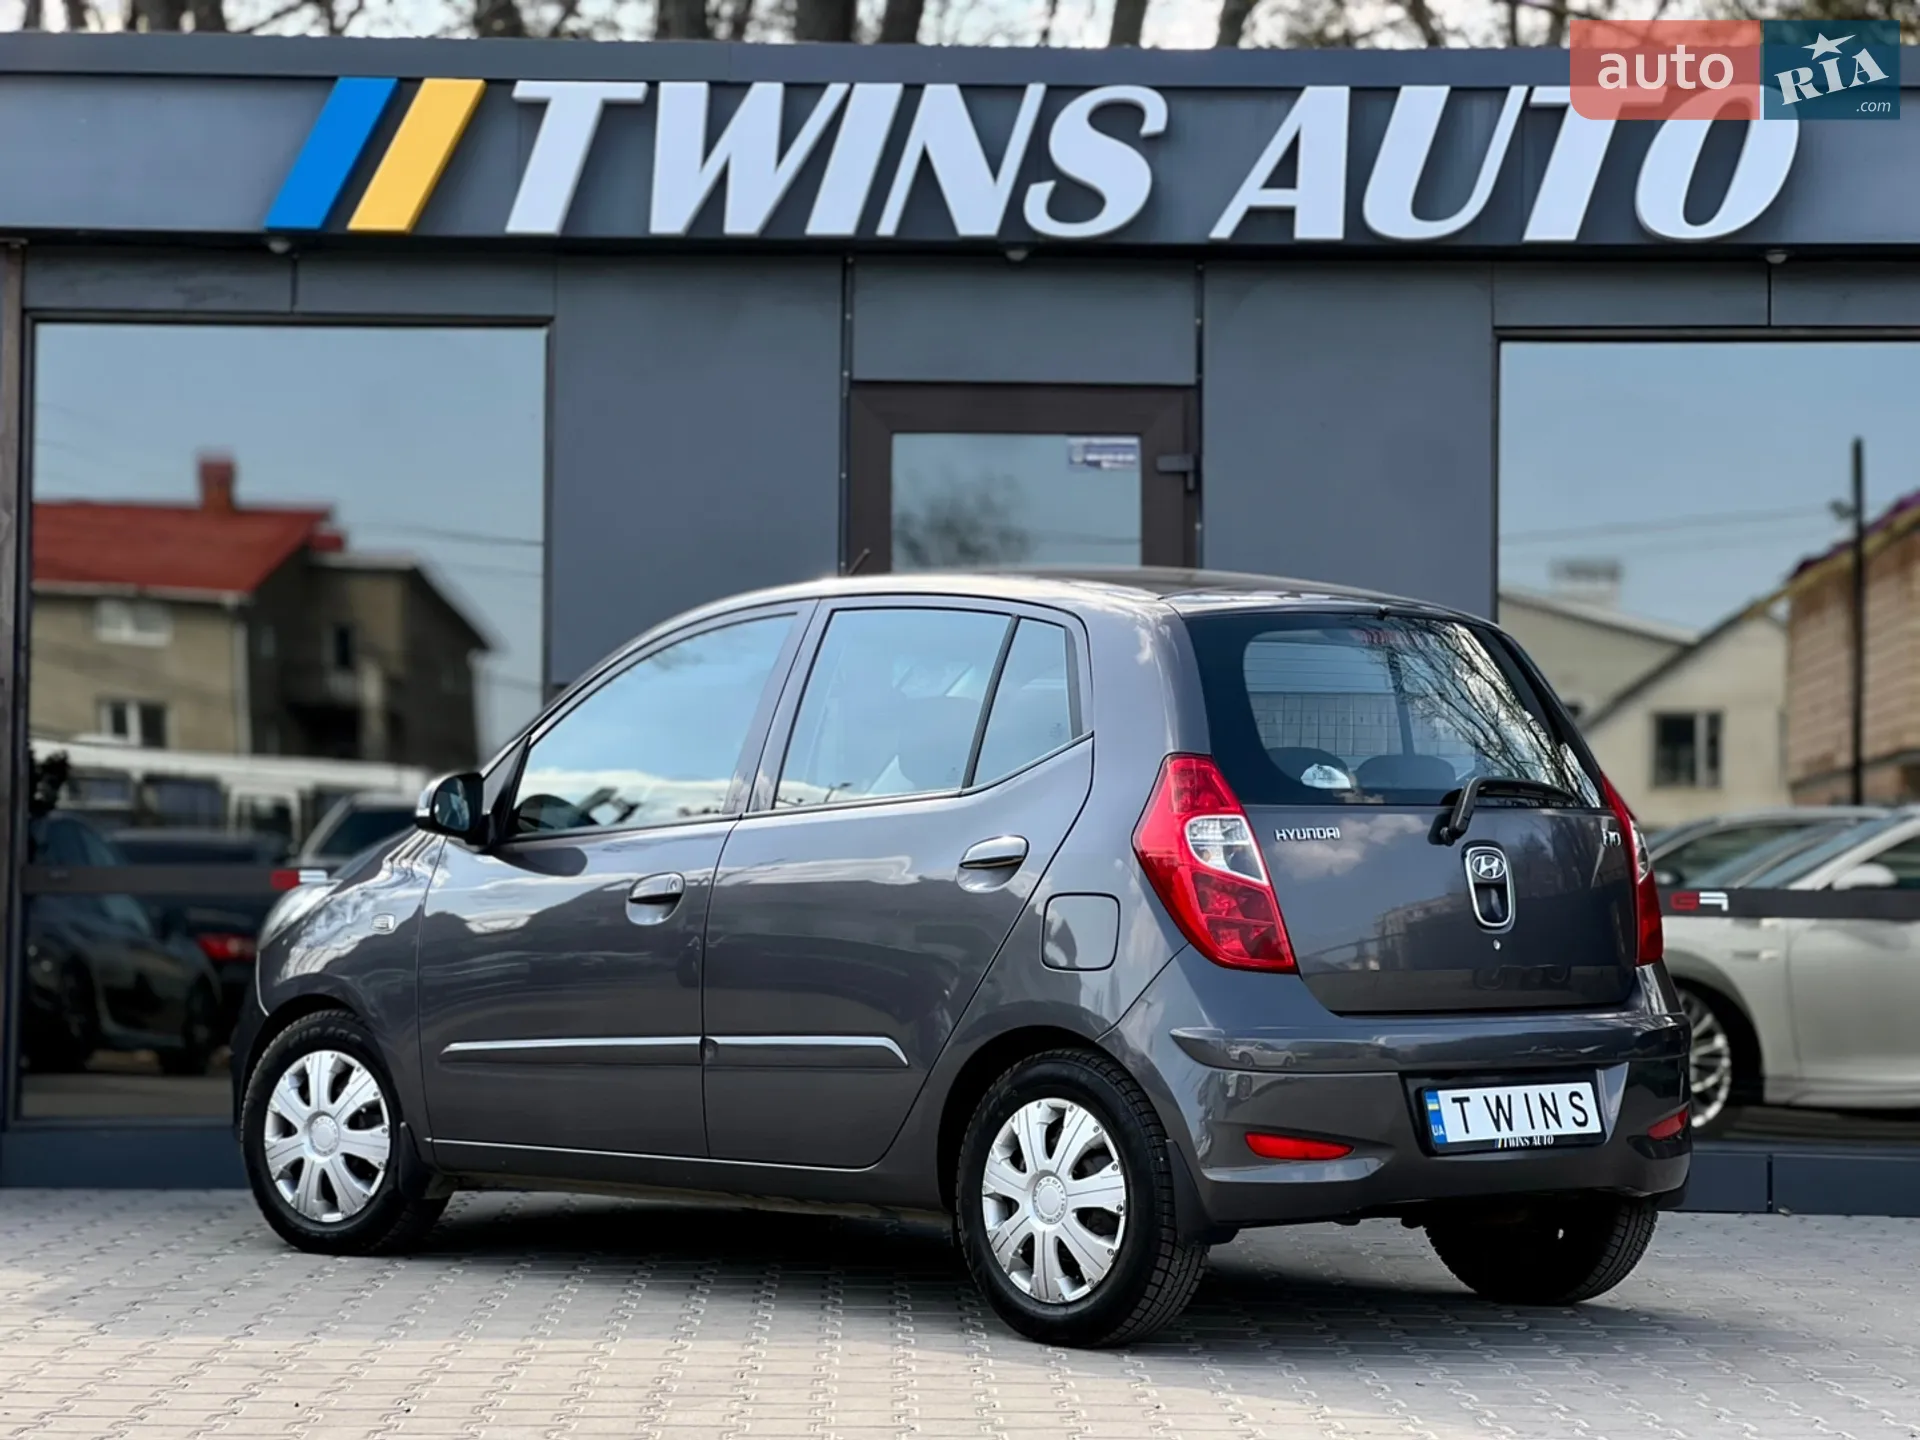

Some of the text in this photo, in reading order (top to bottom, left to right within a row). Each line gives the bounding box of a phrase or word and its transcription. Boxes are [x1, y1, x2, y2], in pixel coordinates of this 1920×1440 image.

[505, 80, 1800, 241] TWINS AUTO
[1274, 827, 1341, 842] HYUNDAI
[1431, 1124, 1445, 1136] UA
